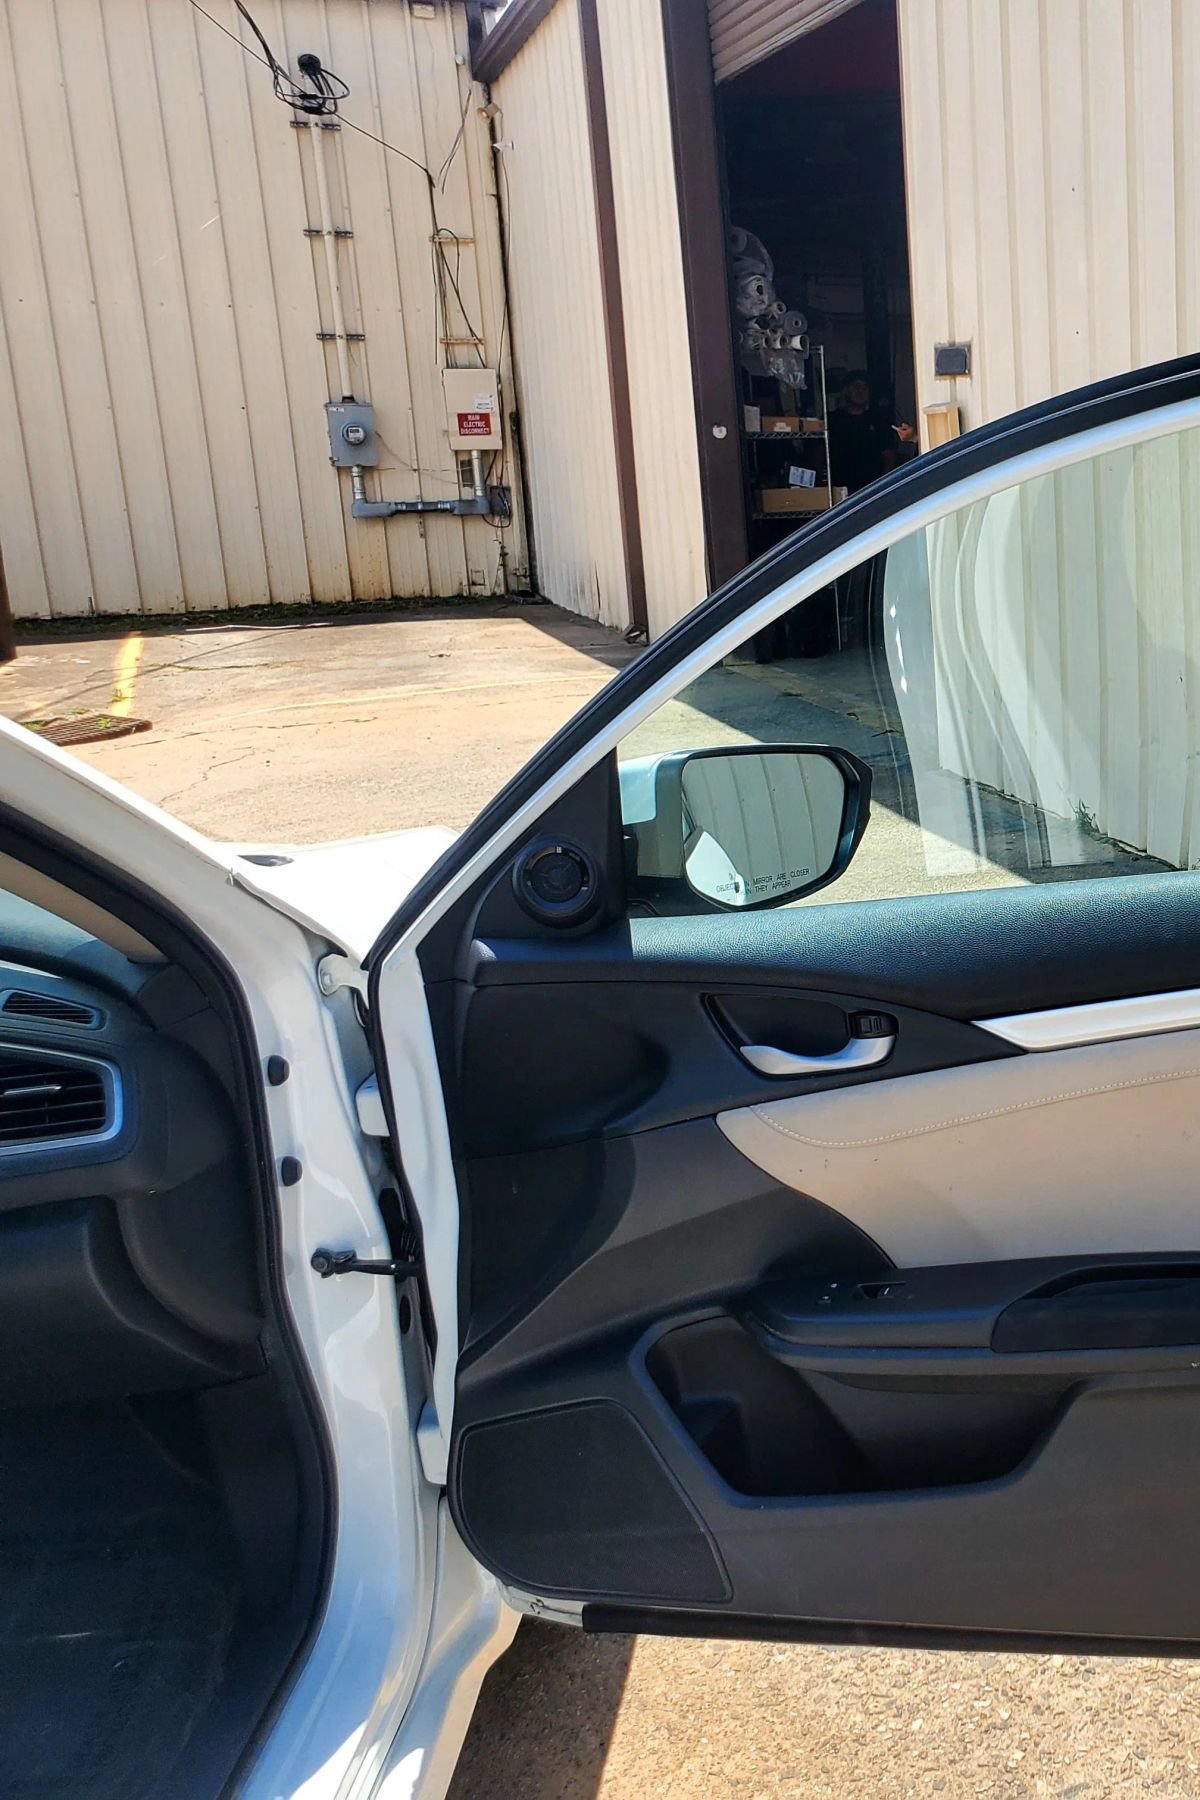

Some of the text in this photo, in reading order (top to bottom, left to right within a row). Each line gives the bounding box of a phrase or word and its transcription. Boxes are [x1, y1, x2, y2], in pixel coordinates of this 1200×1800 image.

[753, 876, 773, 885] MIRROR
[776, 873, 787, 881] ARE
[790, 868, 810, 878] CLOSER
[755, 884, 768, 892] THEY
[772, 879, 791, 889] APPEAR
